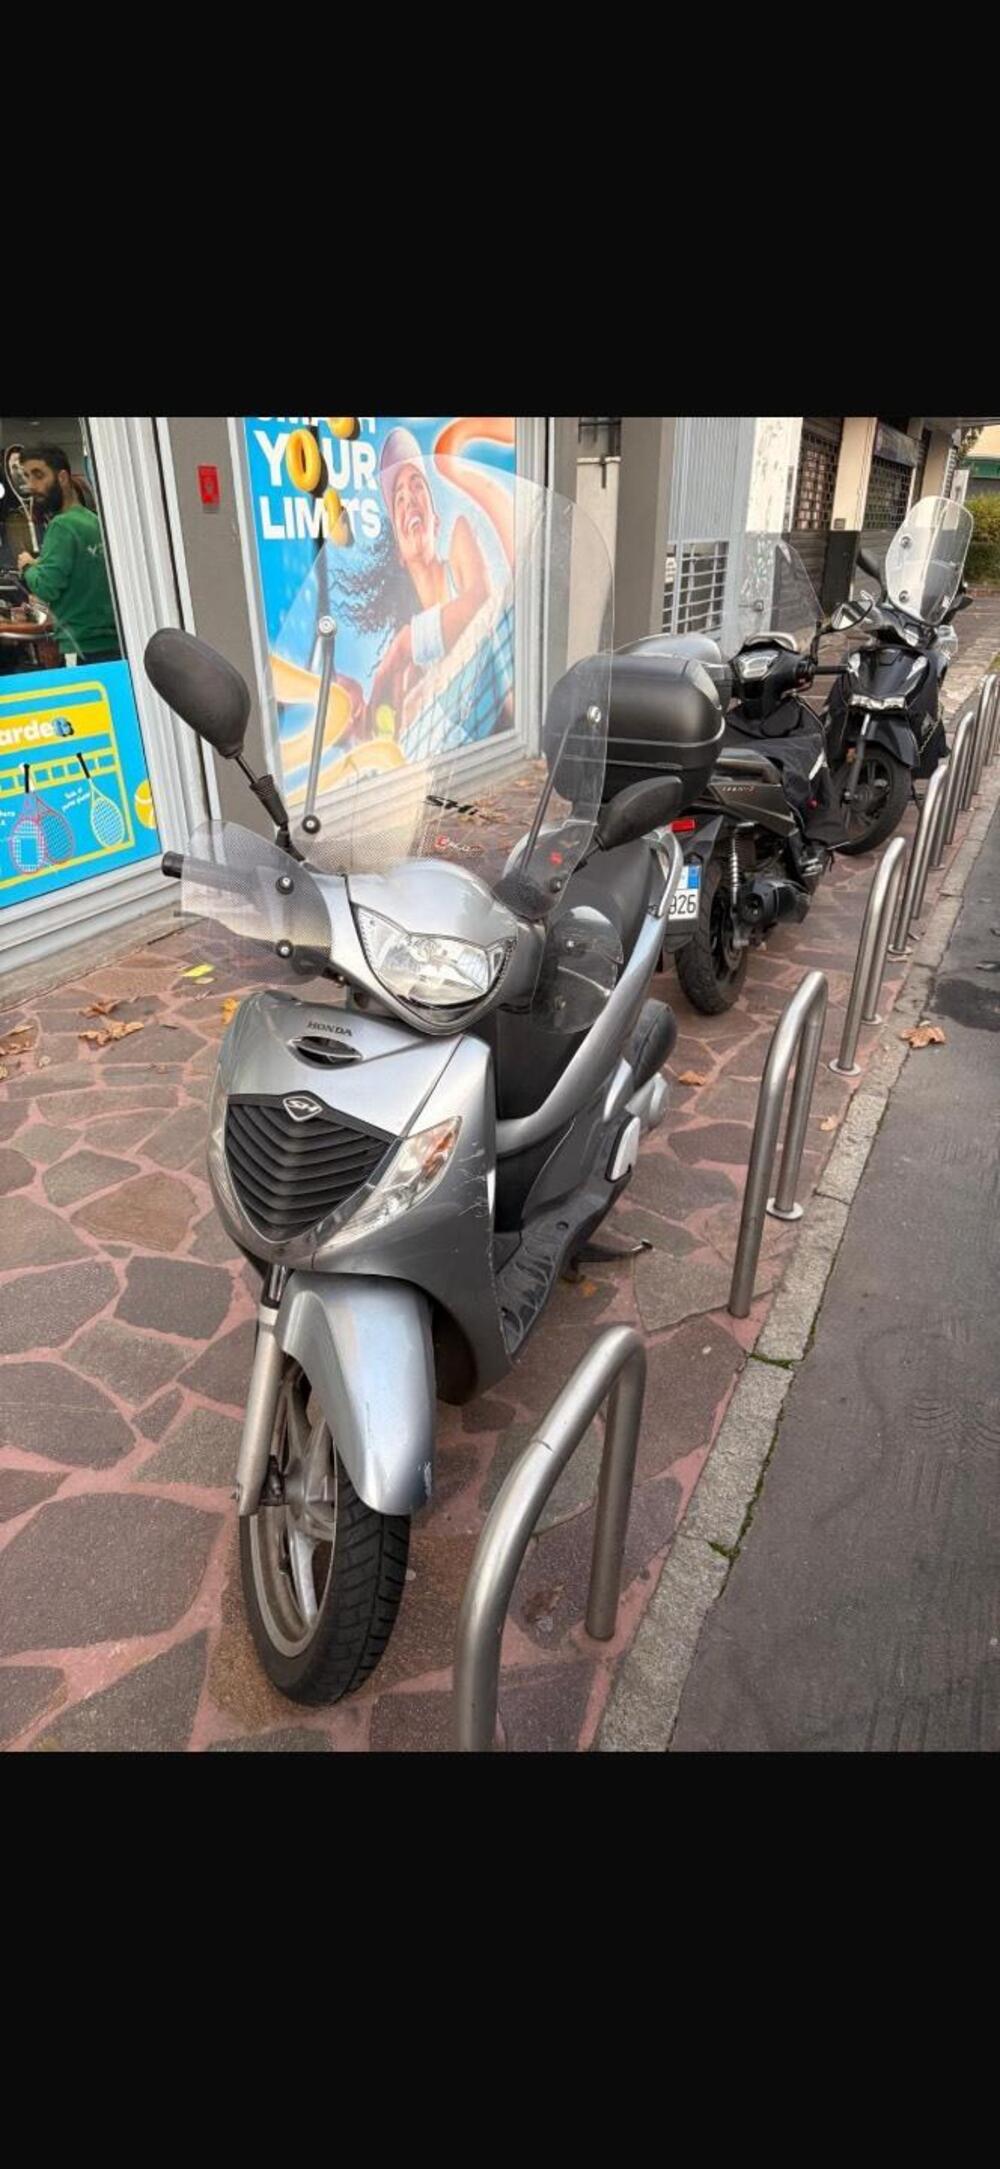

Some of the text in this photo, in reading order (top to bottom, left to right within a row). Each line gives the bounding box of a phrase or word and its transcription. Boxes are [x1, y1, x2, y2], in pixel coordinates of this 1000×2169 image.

[253, 429, 378, 491] YOUR
[259, 495, 381, 540] LIMTS
[306, 1020, 353, 1037] HONDA
